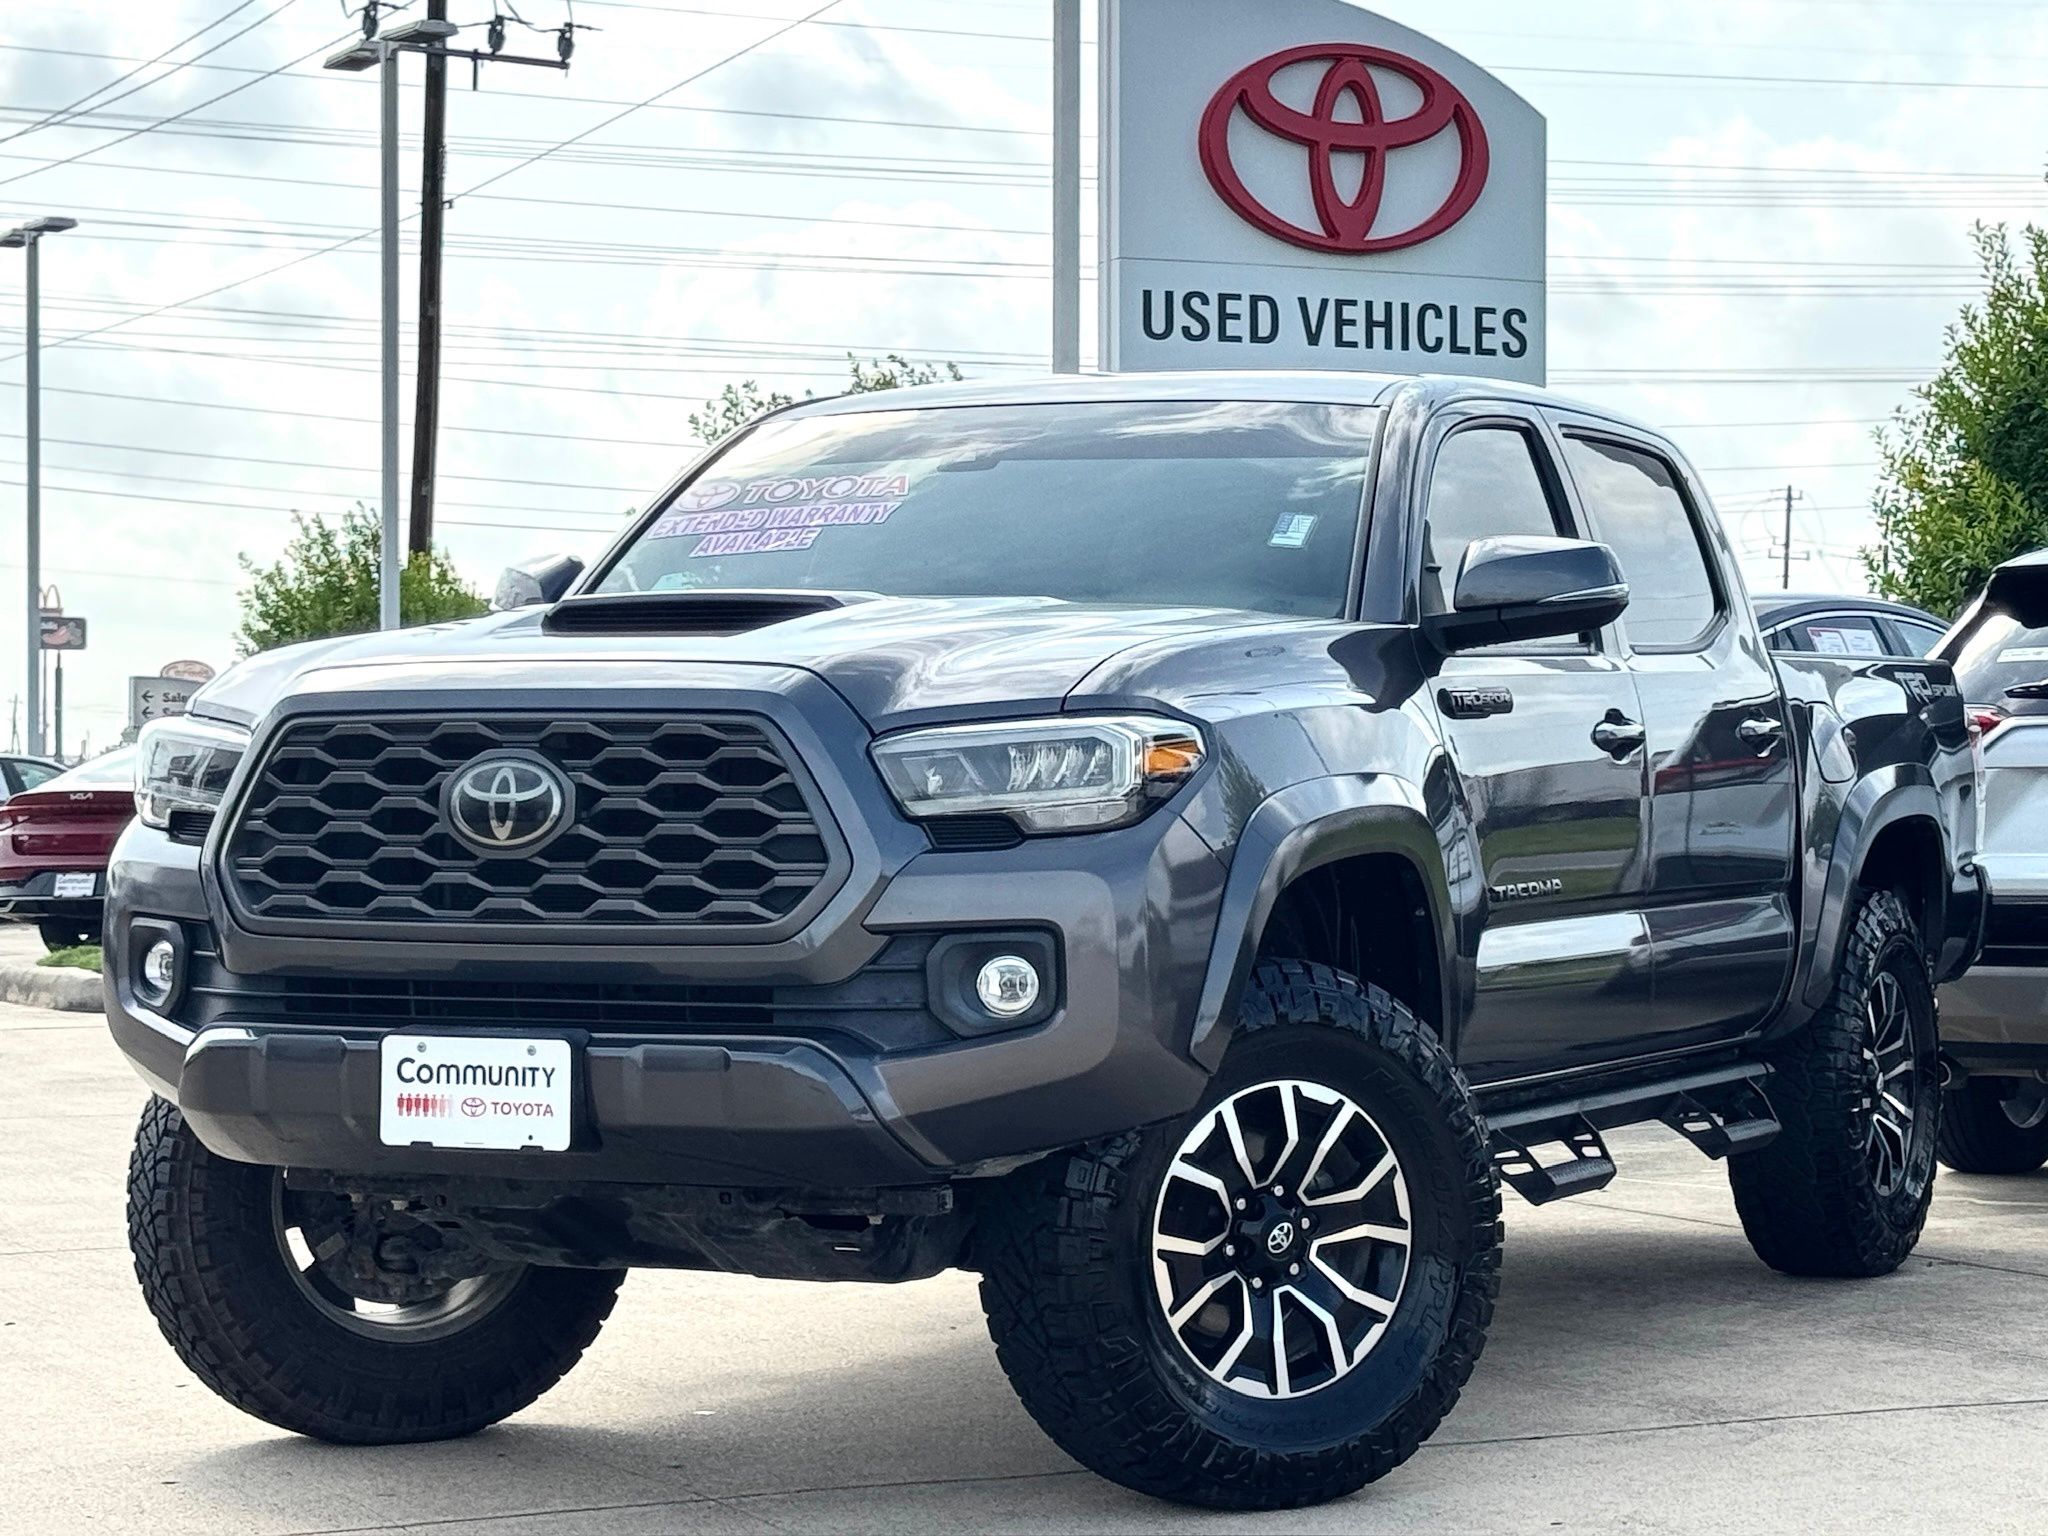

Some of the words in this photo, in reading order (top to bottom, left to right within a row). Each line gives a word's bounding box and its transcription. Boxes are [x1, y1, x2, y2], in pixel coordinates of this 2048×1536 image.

[1142, 288, 1280, 344] USED
[1298, 296, 1528, 358] VEHICLES
[743, 476, 909, 503] TOYOTA
[655, 510, 767, 536] EXTENDED
[768, 503, 897, 527] WARRANTY
[698, 529, 817, 552] AVAILABLE
[1893, 671, 1932, 705] TRD
[1491, 878, 1562, 901] TACOMA
[491, 1101, 554, 1117] TOYOTA
